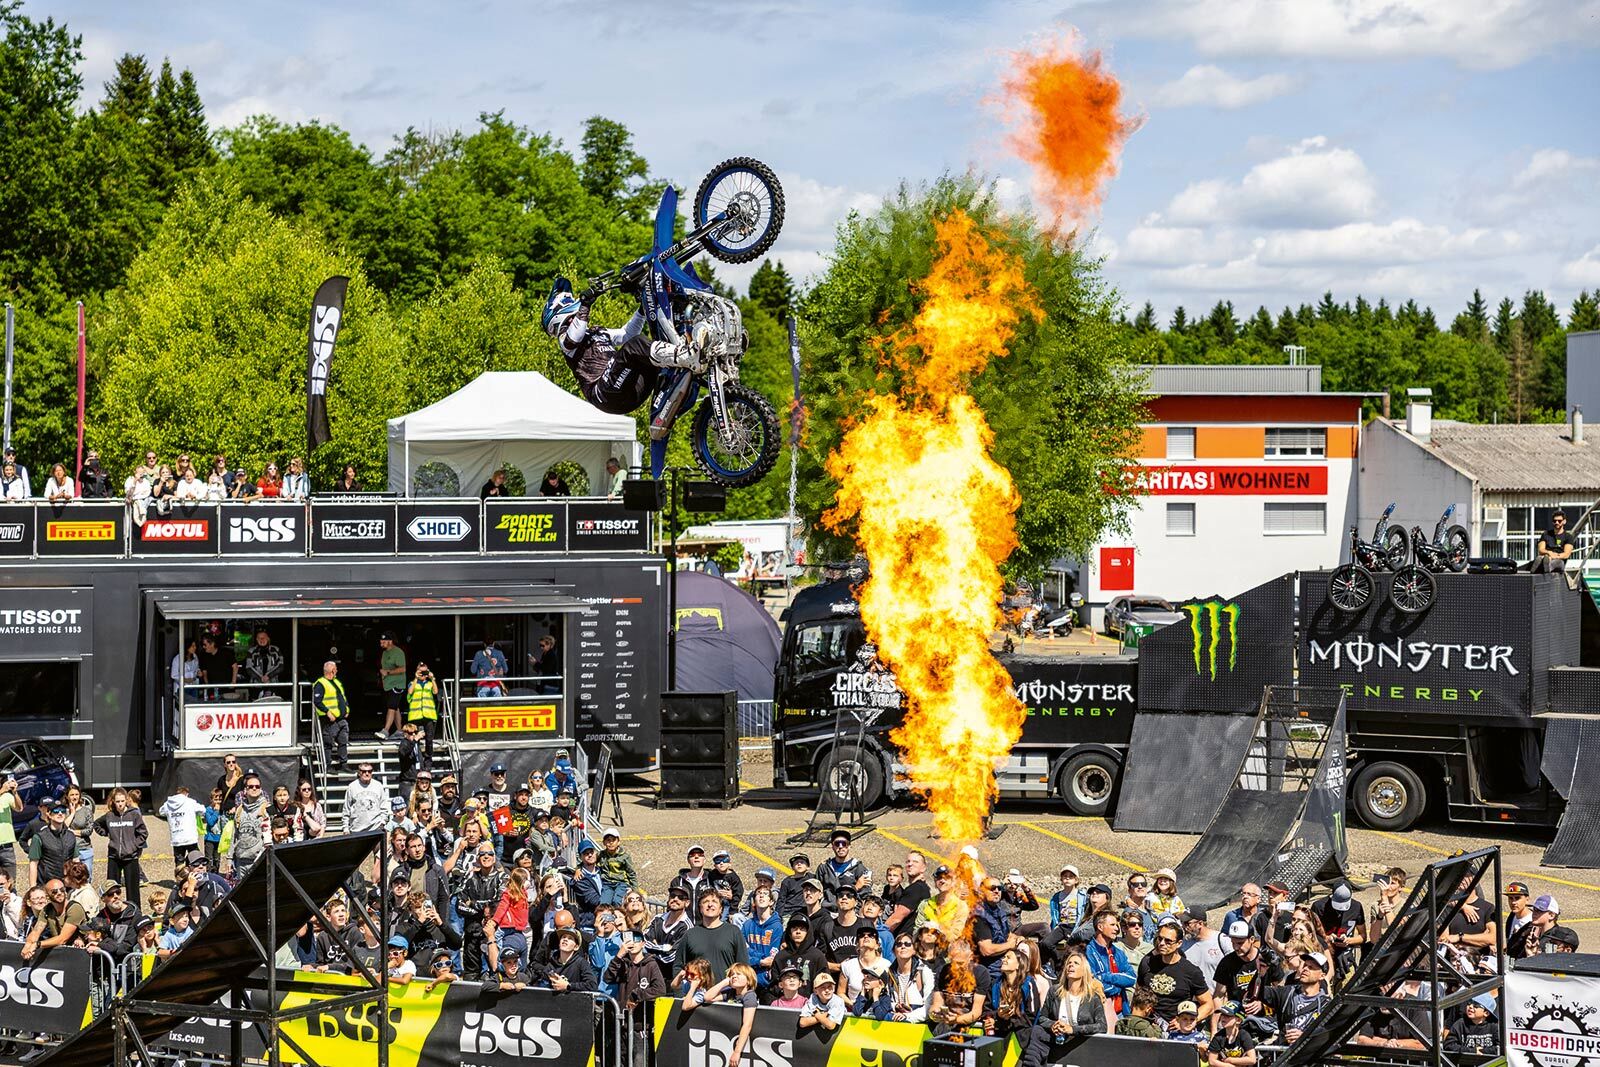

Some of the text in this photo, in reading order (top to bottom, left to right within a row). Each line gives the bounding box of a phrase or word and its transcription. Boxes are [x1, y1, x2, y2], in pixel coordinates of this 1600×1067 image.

[645, 279, 656, 312] YAMAHA
[613, 366, 632, 390] YAMAHA
[1119, 471, 1208, 490] CARITAS
[1219, 472, 1310, 489] WOHNEN
[325, 522, 383, 537] Muc-Off
[416, 521, 461, 536] SHOEI
[495, 514, 553, 530] SPORTS
[594, 519, 639, 530] TISSOT
[49, 524, 113, 538] PIRELLI
[144, 523, 205, 538] MOTUL
[508, 528, 558, 542] ZONE.CH
[0, 610, 82, 625] TISSOT
[38, 626, 62, 634] SINCE
[64, 626, 82, 634] 1853
[1309, 635, 1519, 676] MONSTER
[836, 672, 897, 693] CIRCUS
[832, 691, 866, 706] TRIAL
[1014, 679, 1135, 704] MONSTER
[1340, 684, 1484, 702] ENERGY
[469, 708, 552, 729] PIRELLI
[1026, 707, 1117, 717] ENERGY
[216, 712, 282, 730] YAMAHA
[829, 935, 861, 952] BROOKL
[169, 1030, 205, 1044] ixs.com
[1544, 1056, 1569, 1064] SURSEE
